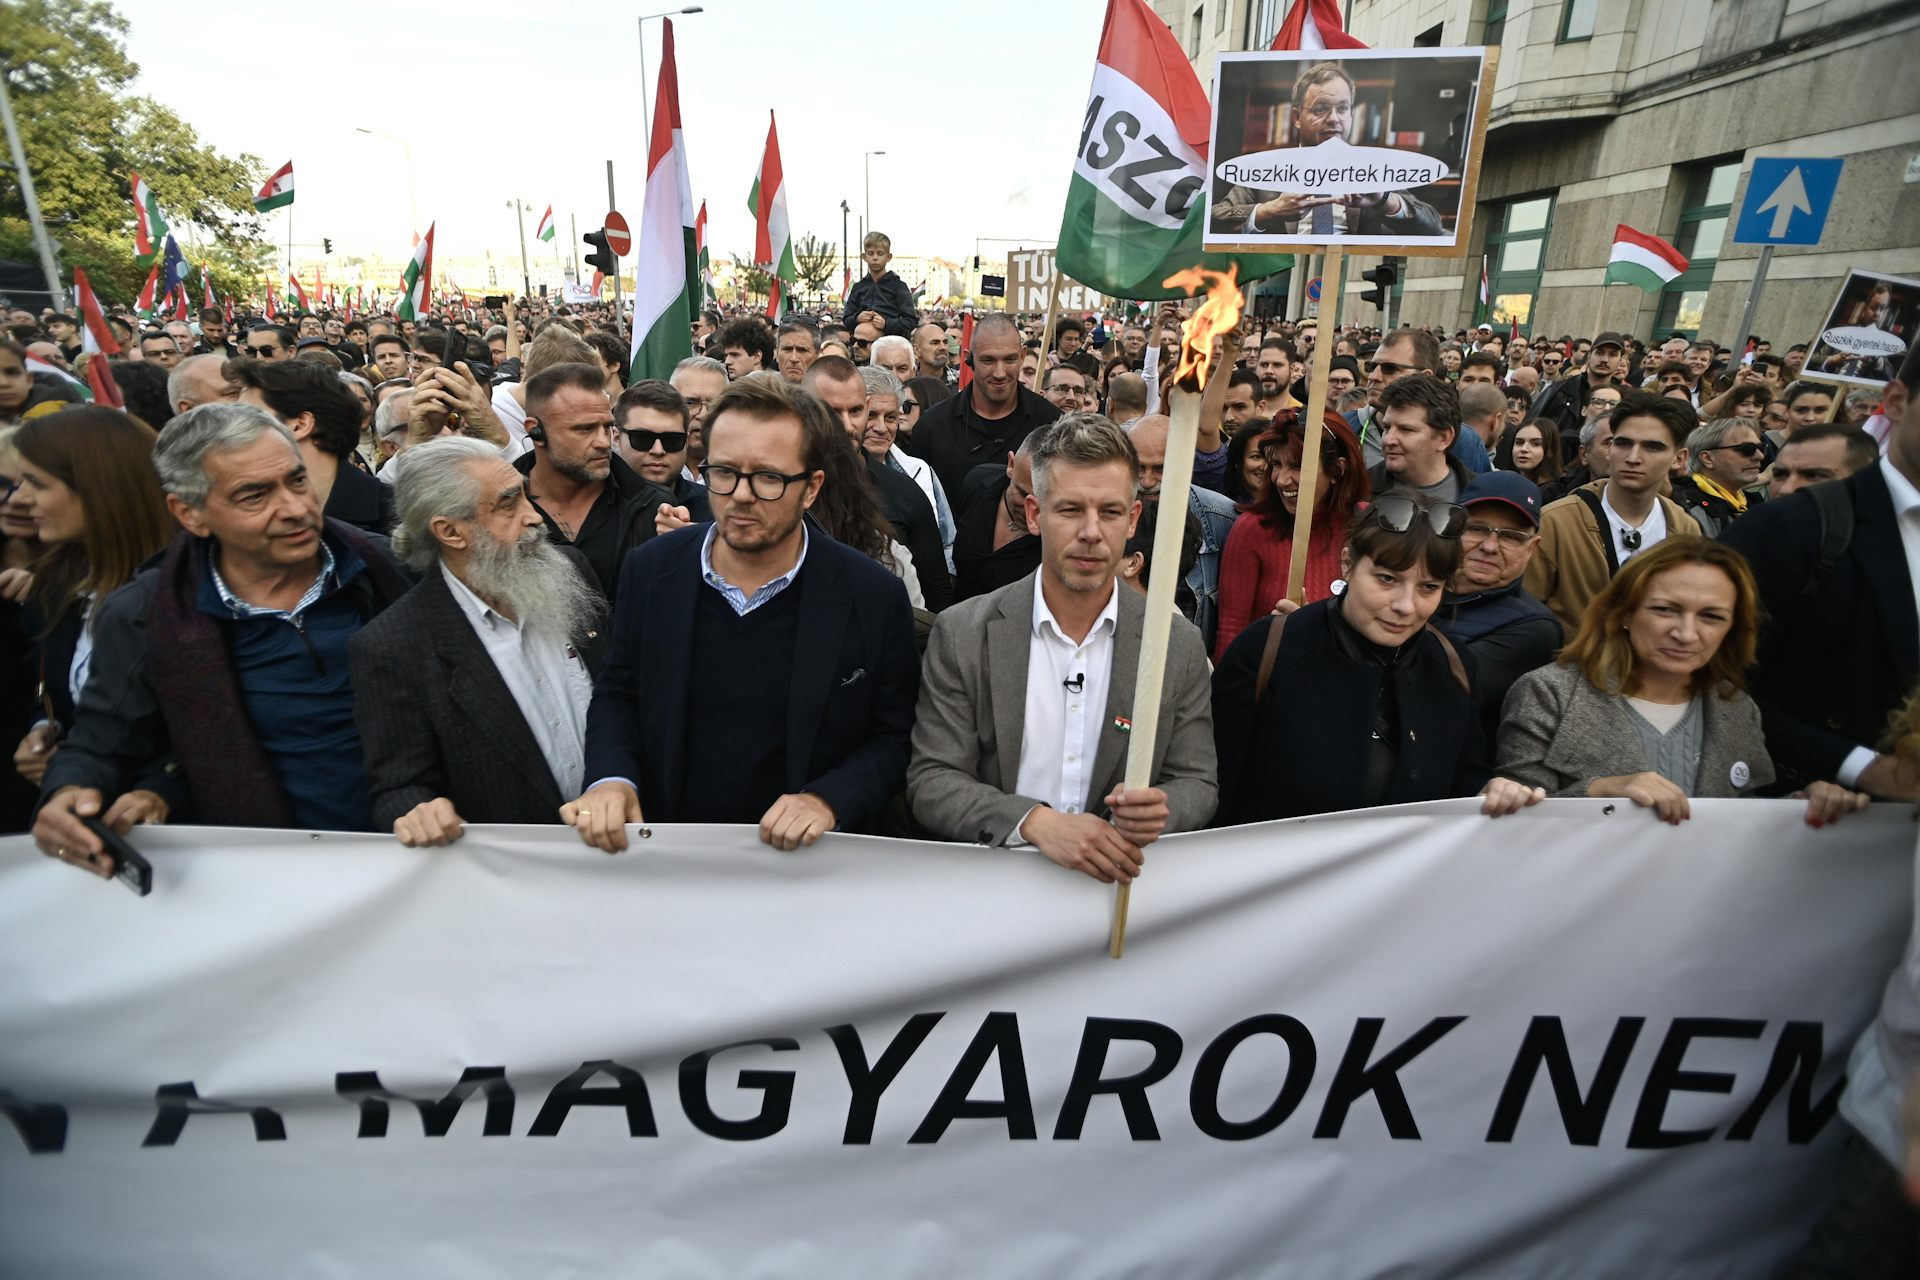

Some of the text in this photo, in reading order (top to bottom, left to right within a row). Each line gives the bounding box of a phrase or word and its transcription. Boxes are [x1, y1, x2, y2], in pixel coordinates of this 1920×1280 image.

[1223, 164, 1299, 182] Ruszkik
[1303, 164, 1378, 187] gyertek
[1383, 163, 1431, 183] haza
[1823, 331, 1852, 347] Ruszkik
[335, 1012, 1469, 1146] MAGYAROK
